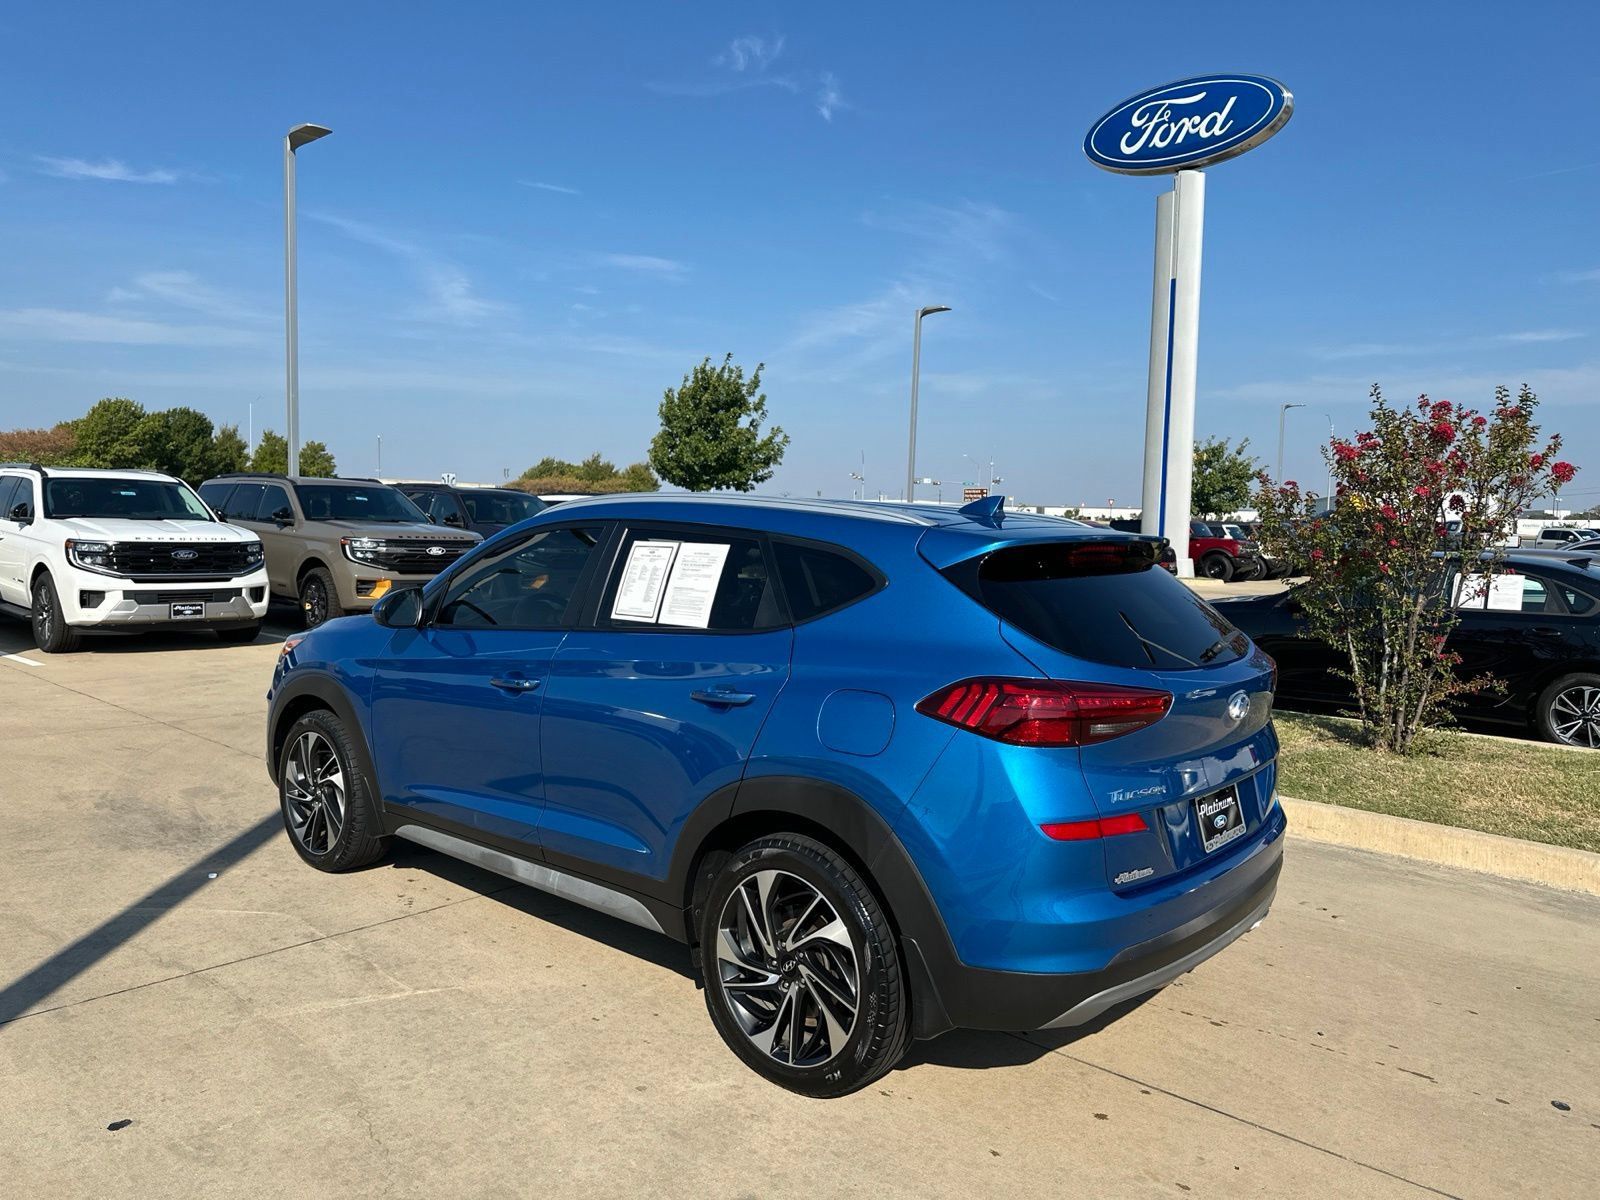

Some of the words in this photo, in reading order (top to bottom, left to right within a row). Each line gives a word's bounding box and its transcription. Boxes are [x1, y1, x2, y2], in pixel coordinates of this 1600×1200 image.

[1119, 90, 1239, 156] Ford
[176, 550, 195, 559] Ford
[1199, 796, 1236, 819] Platinum
